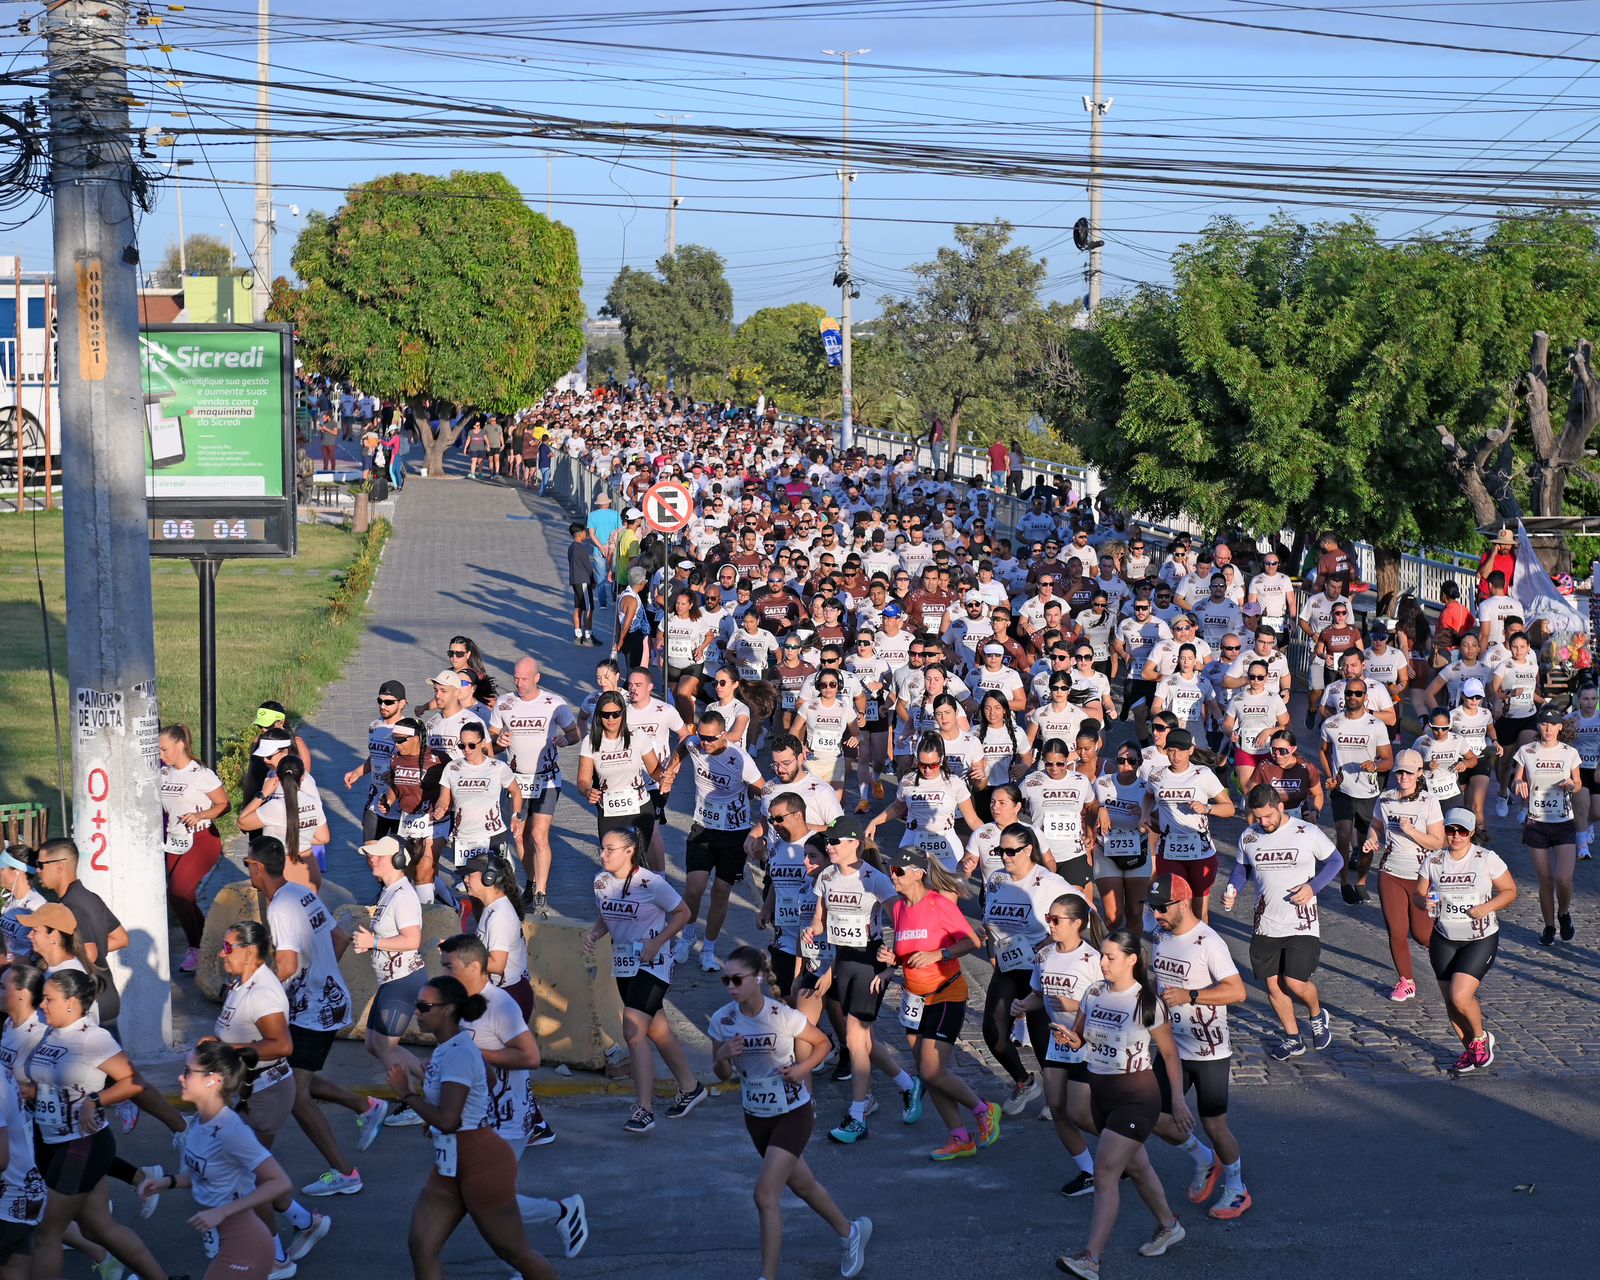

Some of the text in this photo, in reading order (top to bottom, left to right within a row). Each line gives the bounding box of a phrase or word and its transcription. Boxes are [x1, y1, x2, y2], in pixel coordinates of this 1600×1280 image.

[177, 345, 264, 368] Sicredi
[180, 377, 224, 388] Simplifique
[198, 398, 230, 406] vendas
[197, 408, 252, 417] maquininha
[211, 418, 241, 426] Sicredi
[657, 492, 678, 523] E
[880, 651, 906, 659] CAIXA
[84, 690, 114, 708] AMOR
[79, 709, 122, 727] DE VOLTA
[816, 716, 840, 724] CAIXA
[510, 720, 542, 728] CAIXA
[1046, 723, 1069, 731] CAIXA
[430, 737, 455, 748] CAIXA
[1338, 736, 1366, 745] CAIXA
[368, 741, 394, 753] CAIXA
[600, 752, 628, 762] CAIXA
[394, 768, 421, 780] CAIXA
[696, 767, 728, 786] CAIXA
[161, 784, 184, 792] CAIXA
[458, 780, 486, 788] CAIXA
[1272, 780, 1299, 788] CAIXA
[1432, 783, 1454, 794] 5807
[911, 793, 941, 801] CAIXA
[1043, 791, 1078, 799] CAIXA
[1158, 790, 1192, 799] CAIXA
[608, 798, 633, 808] 6656
[1534, 800, 1558, 808] 6342
[698, 808, 720, 821] 6658
[1050, 822, 1076, 831] 5830
[920, 840, 946, 850] 6580
[1110, 840, 1134, 848] 5733
[1170, 844, 1196, 852] 5234
[1254, 852, 1294, 862] CAIXA
[770, 867, 802, 878] CAIXA
[1440, 876, 1472, 884] CAIXA
[828, 894, 858, 904] CAIXA
[602, 901, 634, 914] CAIXA
[990, 906, 1025, 918] CAIXA
[830, 926, 862, 938] 10543
[1002, 948, 1024, 962] 6131
[1154, 958, 1185, 975] CAIXA
[1040, 976, 1071, 988] CAIXA
[1091, 1010, 1122, 1023] CAIXA
[743, 1036, 773, 1048] AIXA
[746, 1092, 778, 1104] 6472
